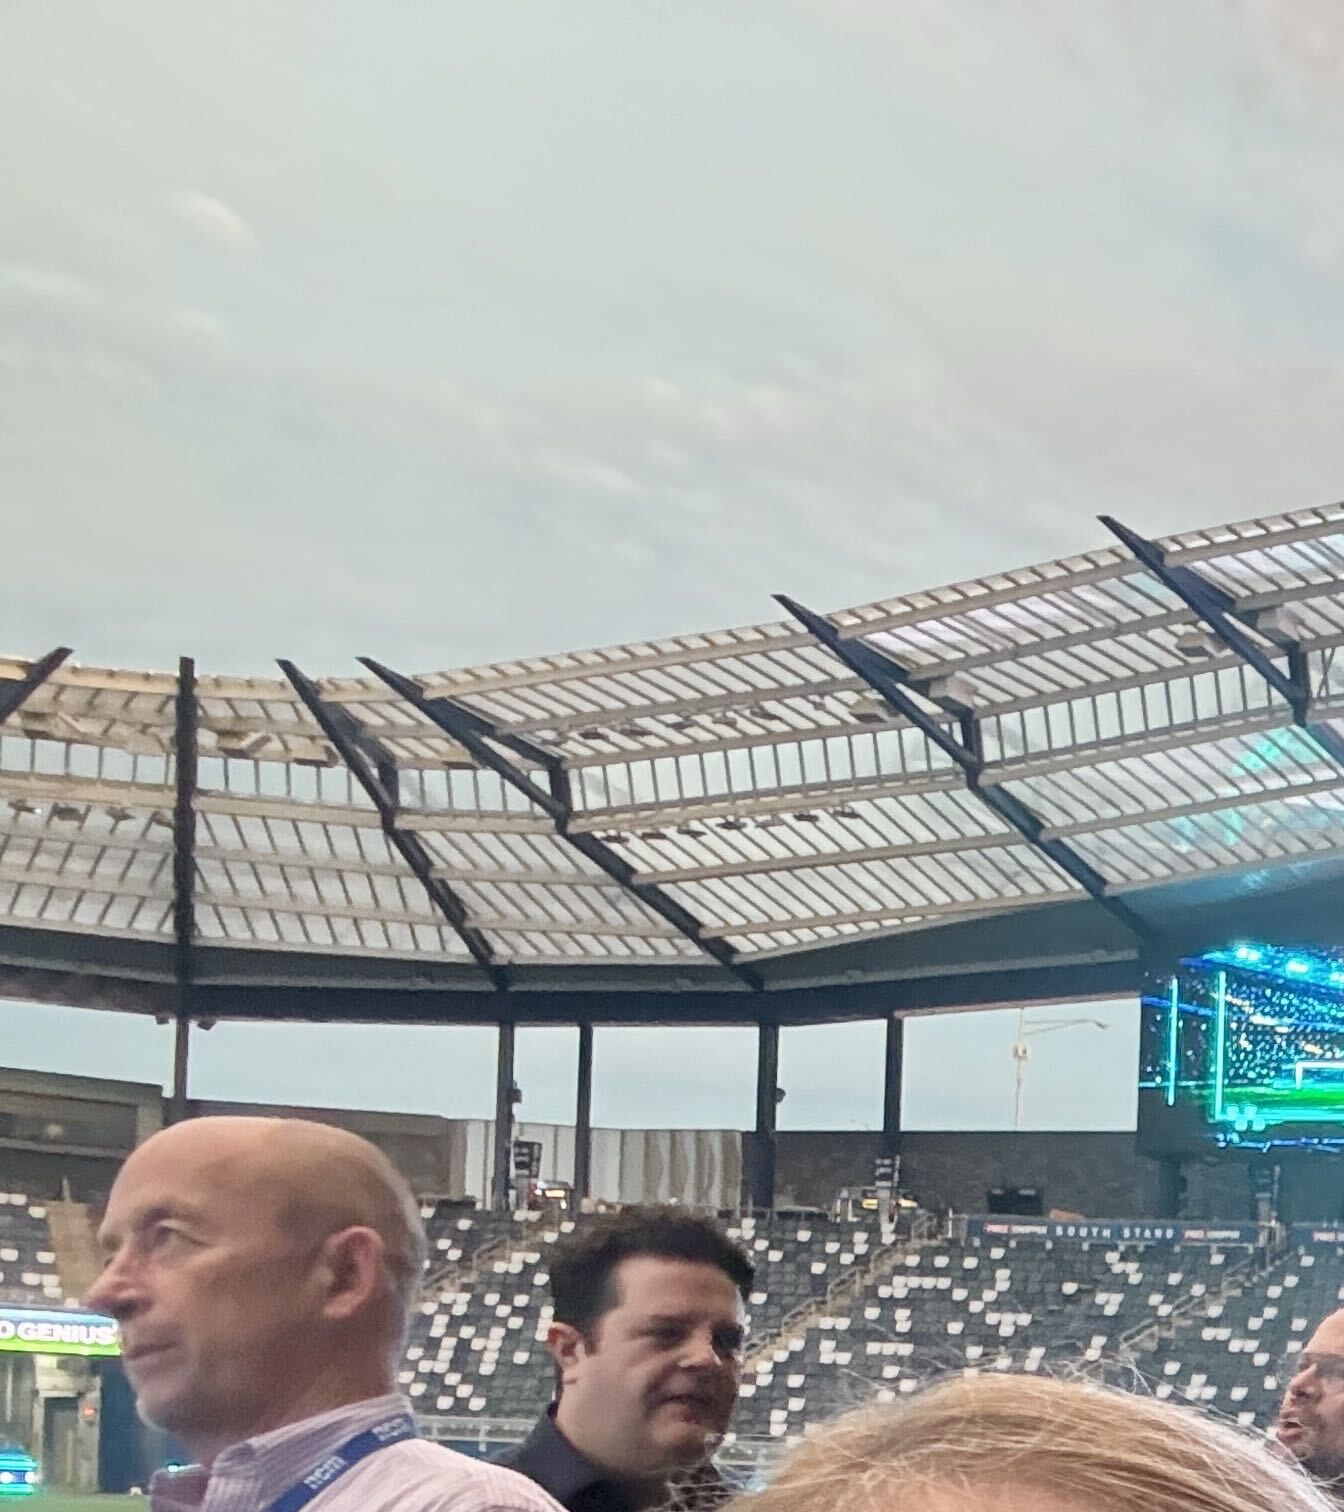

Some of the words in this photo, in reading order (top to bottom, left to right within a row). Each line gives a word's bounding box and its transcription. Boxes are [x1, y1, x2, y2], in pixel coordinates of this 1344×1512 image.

[1056, 1225, 1111, 1239] SOUTH
[1123, 1225, 1175, 1239] STAND
[17, 1321, 117, 1345] GENIUS
